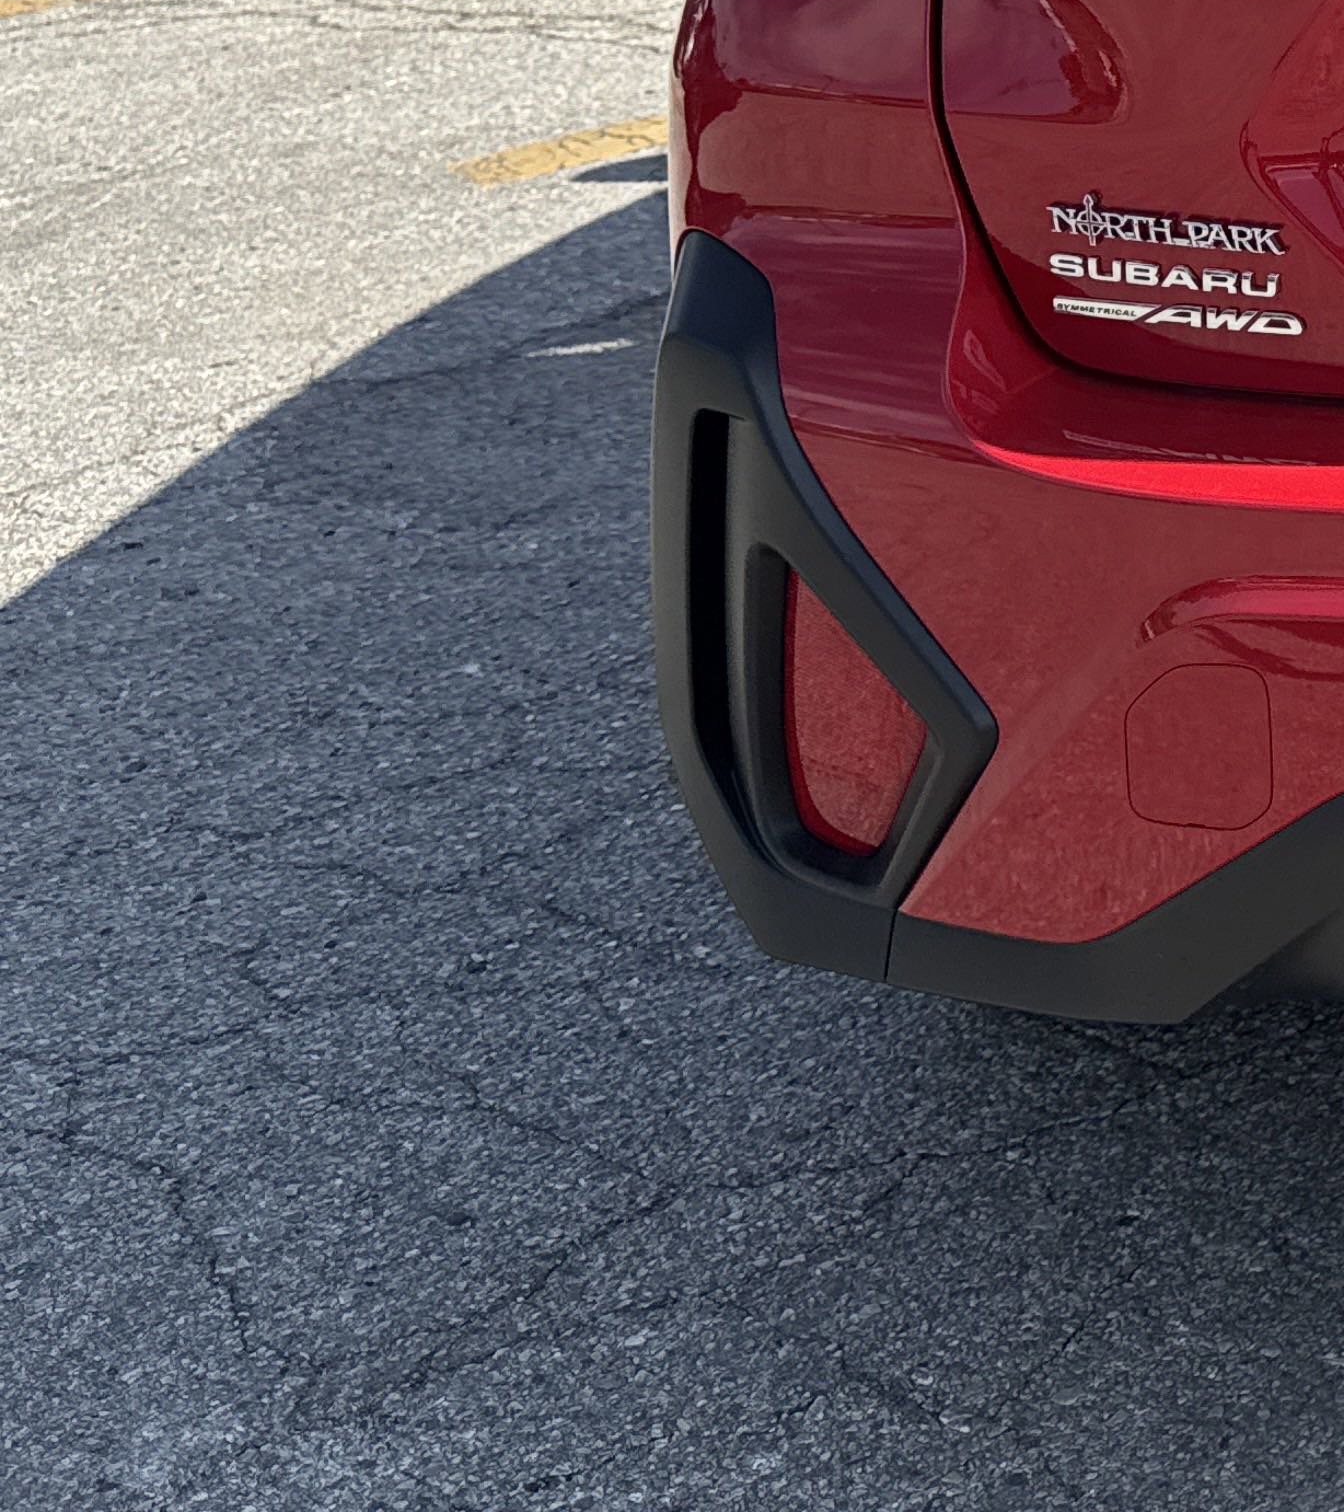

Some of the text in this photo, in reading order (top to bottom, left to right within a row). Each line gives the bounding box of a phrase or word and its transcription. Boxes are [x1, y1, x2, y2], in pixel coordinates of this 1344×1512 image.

[1046, 194, 1286, 255] NORTH PARK
[1049, 253, 1280, 298] SUBARU
[1056, 302, 1303, 336] SYMMETRICAL AWD
